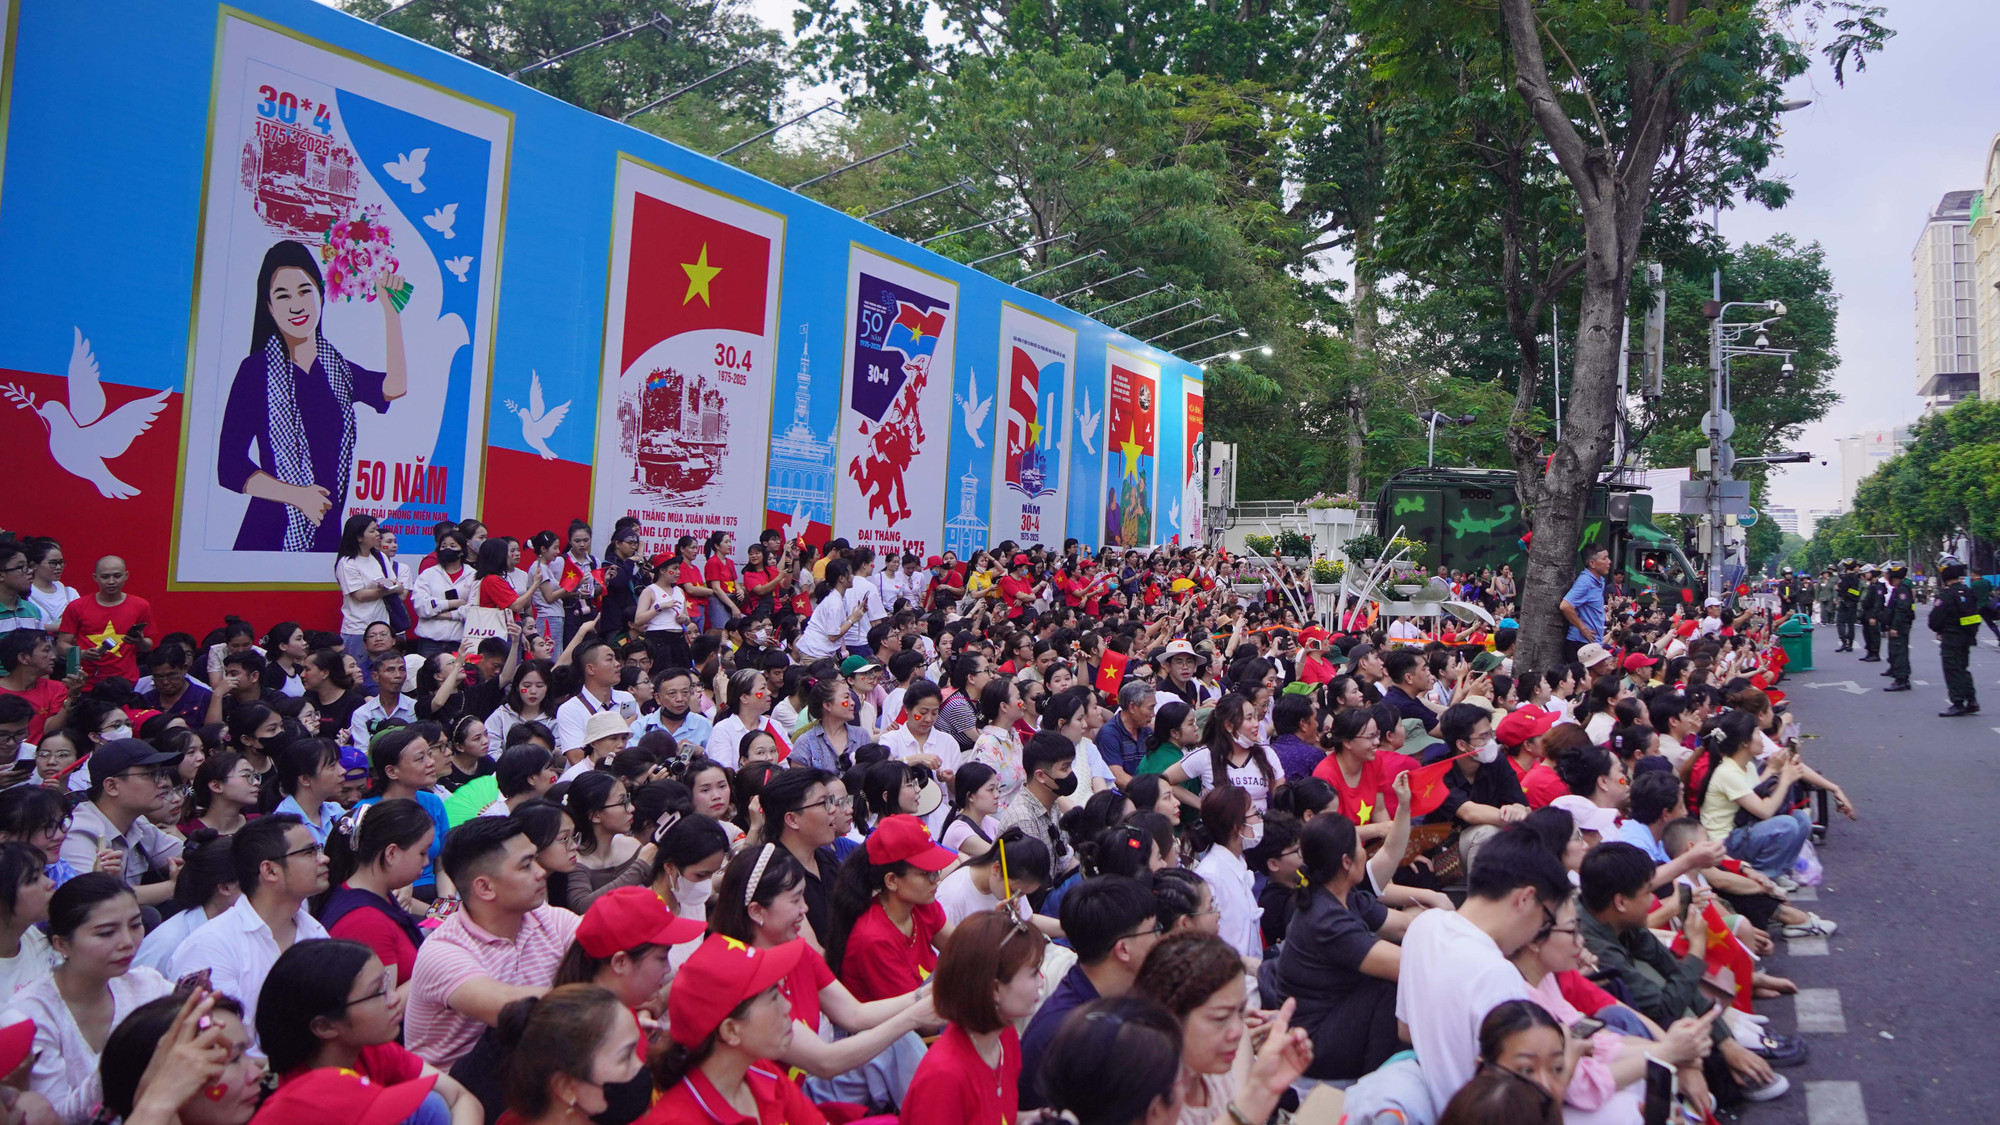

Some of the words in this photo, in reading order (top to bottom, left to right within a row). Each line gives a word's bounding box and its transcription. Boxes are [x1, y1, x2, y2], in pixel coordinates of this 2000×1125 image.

[860, 309, 883, 338] 50
[714, 343, 752, 372] 30.4
[718, 370, 747, 386] 1975-2025
[867, 363, 889, 385] 30-4
[355, 459, 386, 501] 50
[392, 455, 449, 505] NĂM
[371, 504, 386, 520] GIẢI
[387, 507, 411, 520] PHÓNG
[1021, 503, 1041, 515] NĂM
[642, 508, 666, 522] THẮNG
[667, 511, 684, 524] MÙA
[684, 512, 704, 525] XUÂN
[705, 512, 721, 526] NĂM
[722, 516, 738, 527] 1975
[1020, 514, 1040, 532] 30-4
[405, 522, 420, 535] ĐẤT
[693, 526, 709, 540] SỨC
[858, 529, 873, 542] ĐẠI
[875, 527, 901, 542] THẮNG
[1020, 532, 1040, 542] 1975-2025
[468, 628, 496, 636] JAJU
